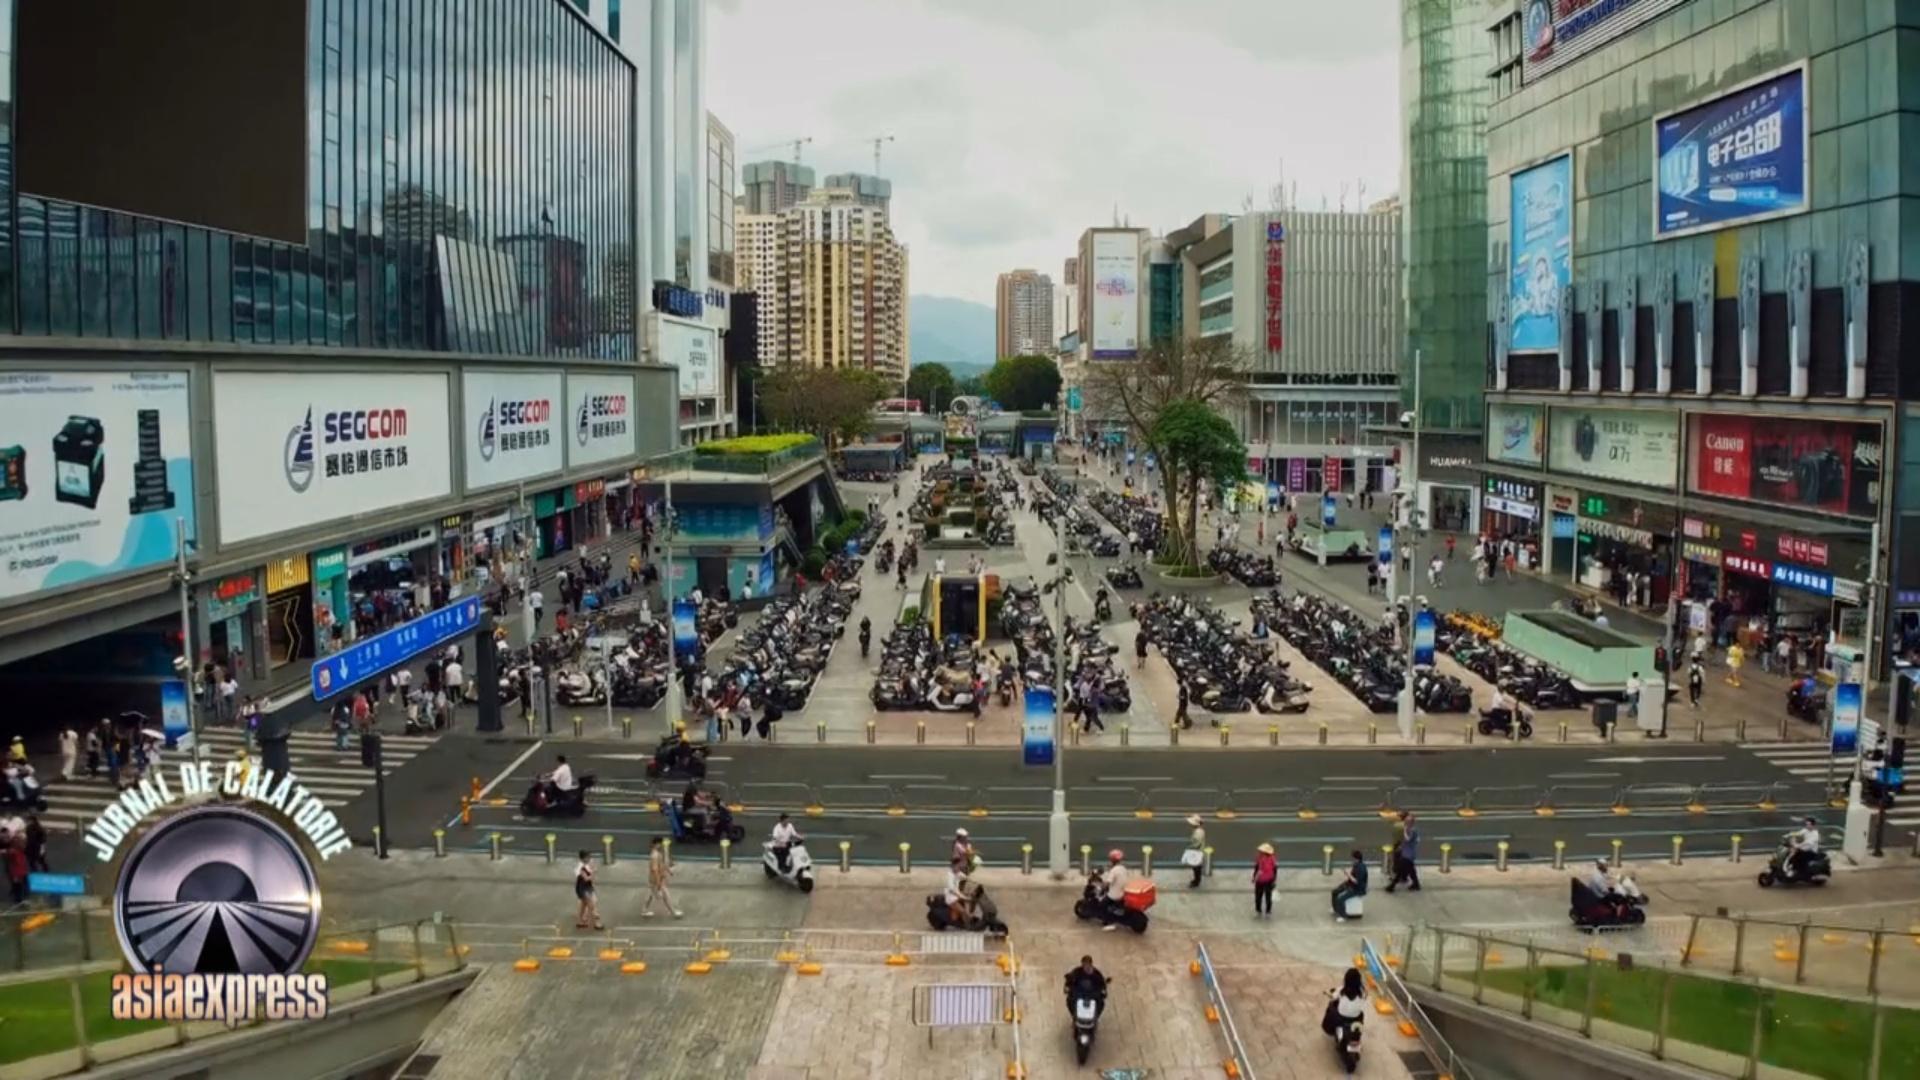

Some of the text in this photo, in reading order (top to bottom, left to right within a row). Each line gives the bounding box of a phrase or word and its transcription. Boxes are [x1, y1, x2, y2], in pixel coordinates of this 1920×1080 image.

[1707, 111, 1782, 168] 电子总部
[500, 399, 550, 426] SEGCOM
[592, 395, 627, 416] SEGCOM
[324, 409, 408, 444] SEGCOM
[1705, 433, 1744, 452] Canon
[325, 446, 408, 478] 赛格通信市场
